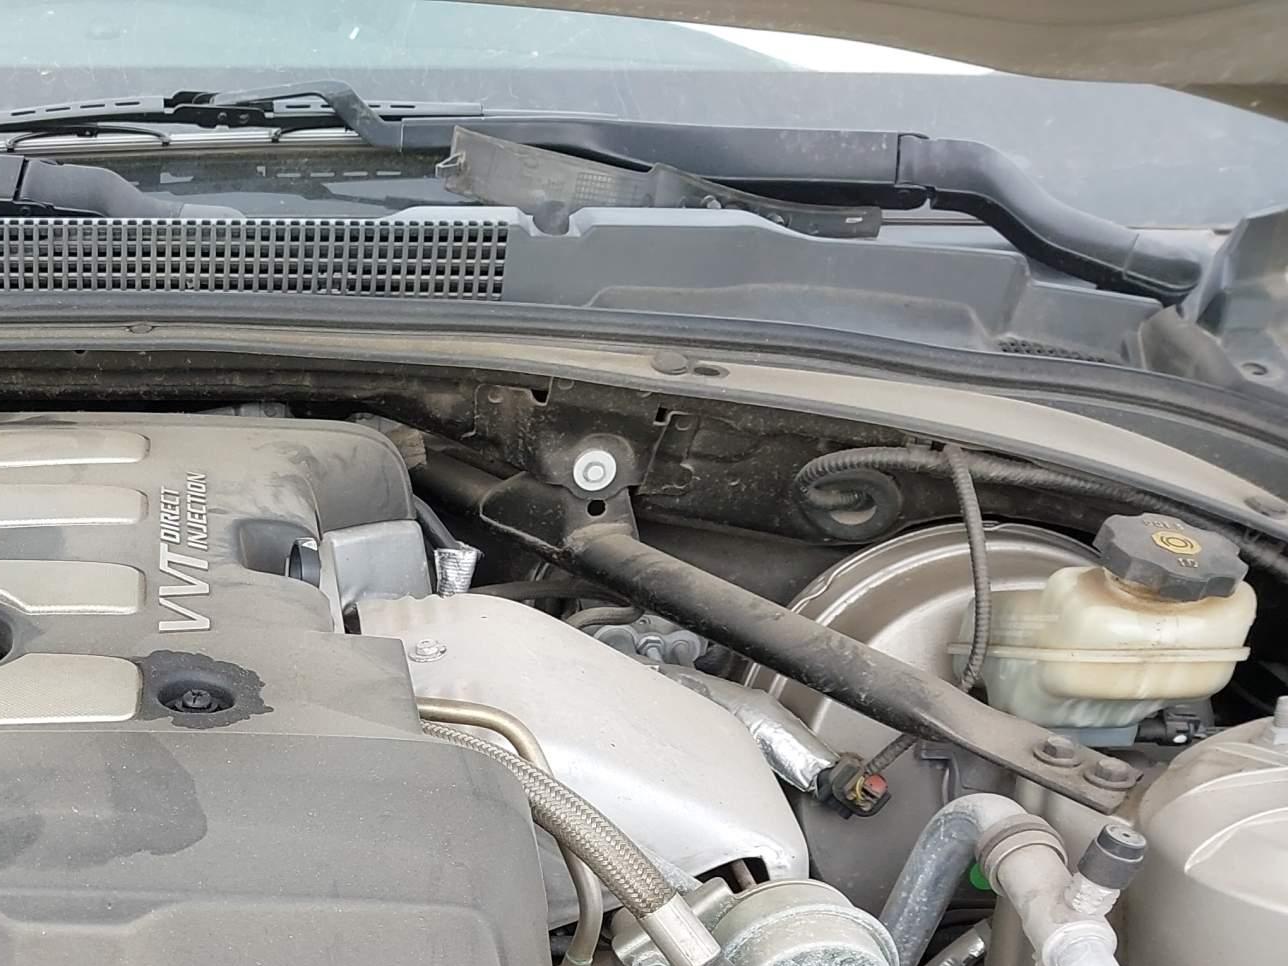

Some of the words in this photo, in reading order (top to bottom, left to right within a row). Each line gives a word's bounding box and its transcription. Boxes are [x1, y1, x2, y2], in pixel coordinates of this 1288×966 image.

[159, 487, 181, 544] DIRECT
[186, 471, 209, 550] INJECTION
[158, 542, 211, 632] VVT
